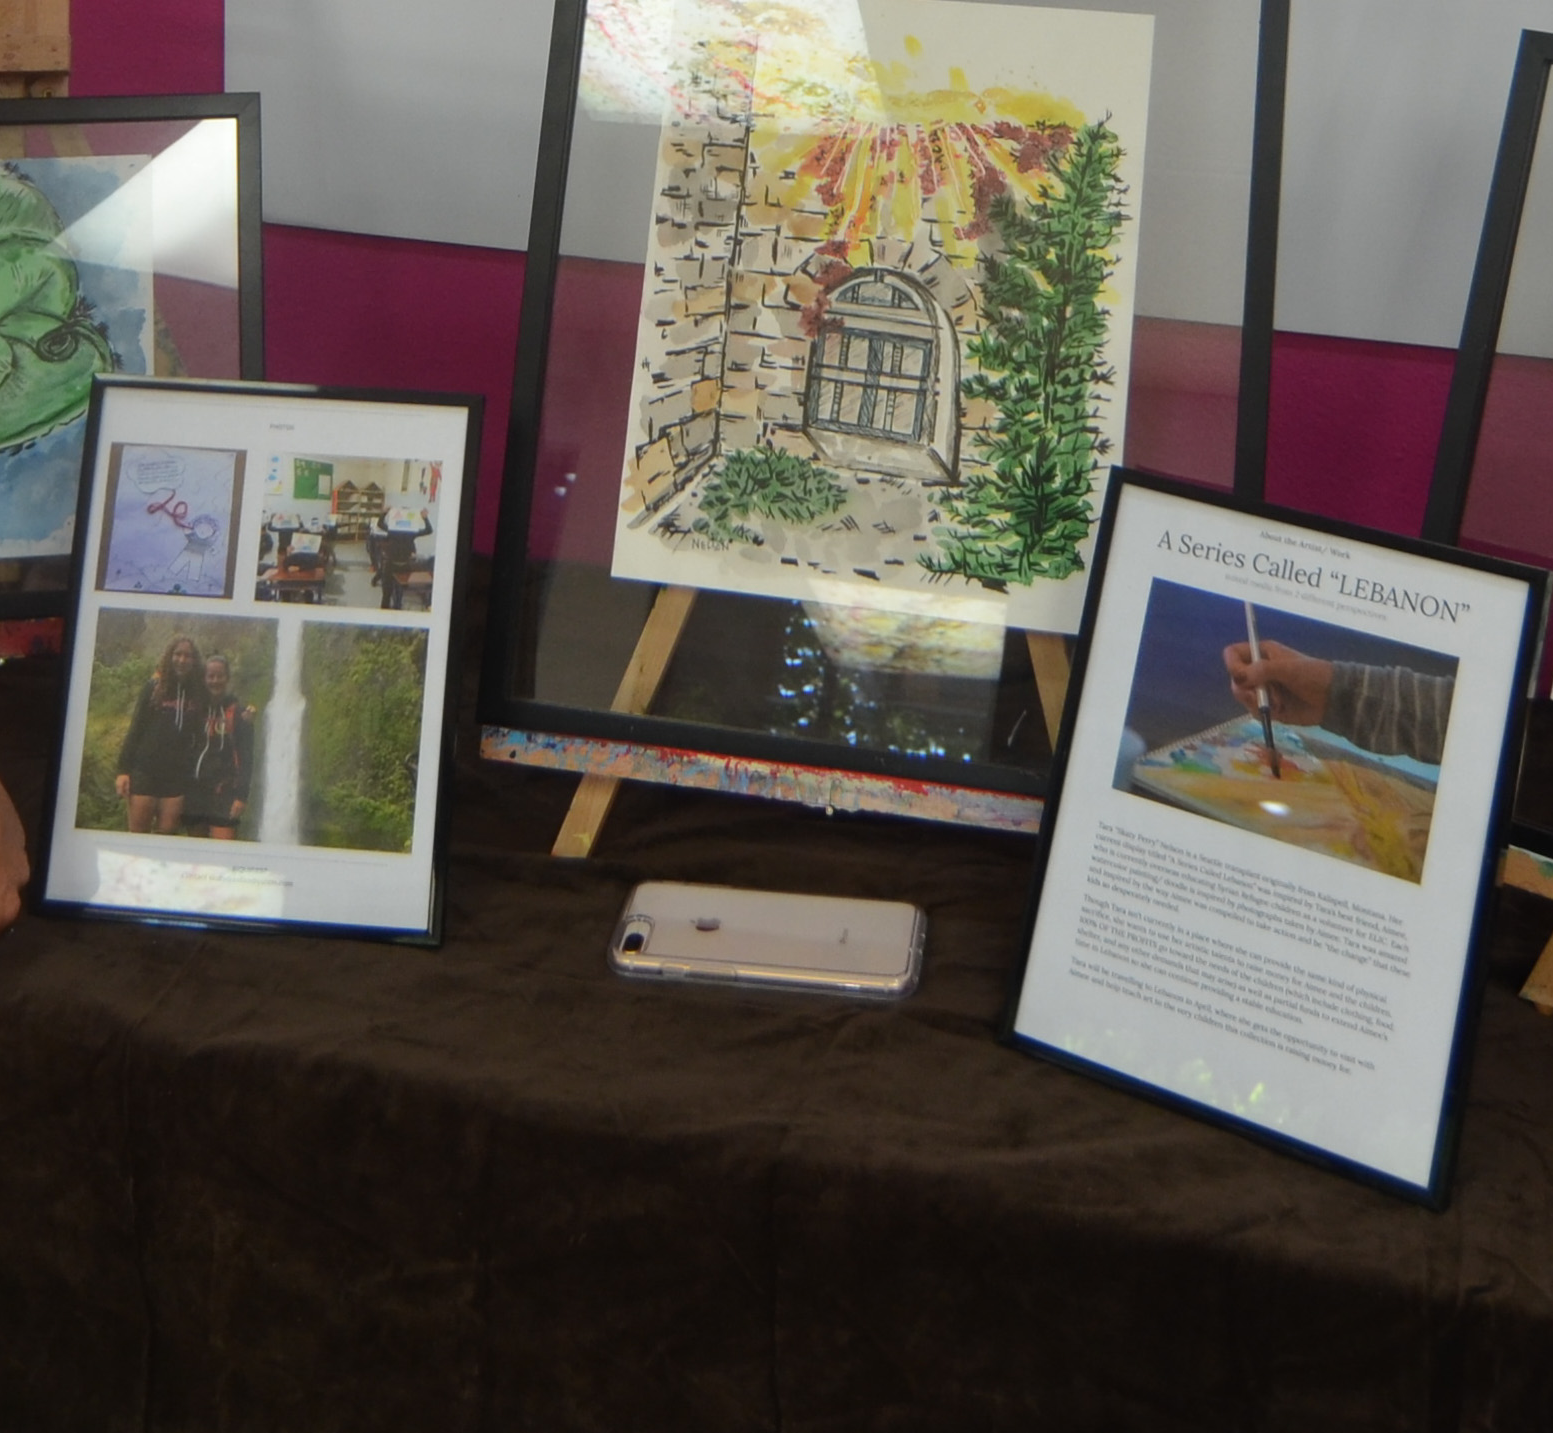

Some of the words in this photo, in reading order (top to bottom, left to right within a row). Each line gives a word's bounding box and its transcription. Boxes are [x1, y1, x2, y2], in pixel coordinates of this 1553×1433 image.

[1259, 530, 1282, 543] About
[1283, 536, 1297, 546] the
[1329, 547, 1350, 559] Work
[1157, 530, 1171, 550] A
[1177, 533, 1245, 568] Series
[1252, 552, 1322, 588] Called
[1330, 571, 1470, 623] “LEBANON”
